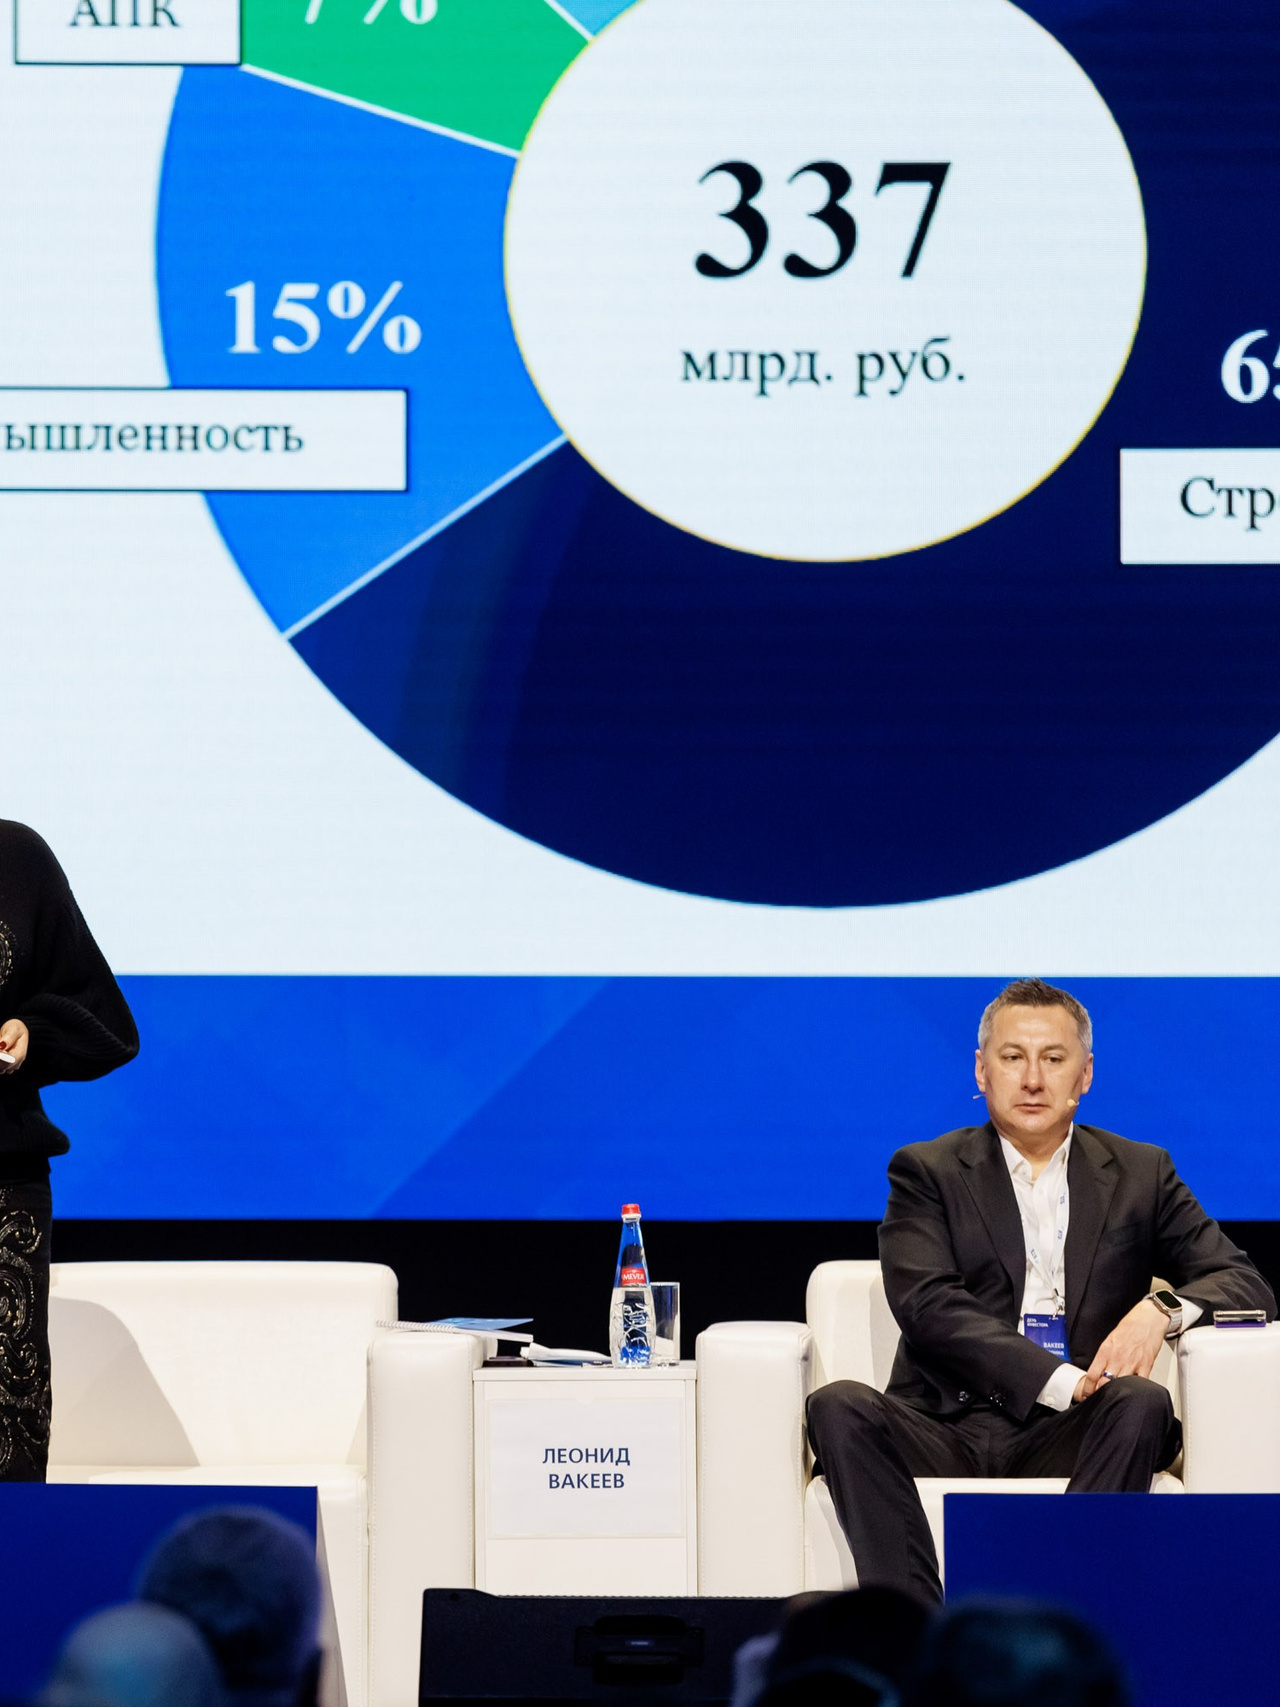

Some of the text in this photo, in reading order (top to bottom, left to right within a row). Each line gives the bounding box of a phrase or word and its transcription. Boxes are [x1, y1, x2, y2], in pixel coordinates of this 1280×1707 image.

[694, 160, 952, 280] 337
[226, 280, 422, 354] 15%
[682, 337, 966, 397] млрд. руб.
[1221, 330, 1280, 404] 6
[1179, 477, 1280, 531] Стр
[542, 1447, 631, 1466] ЛЕОНИД
[548, 1473, 625, 1489] ВАКЕЕВ
